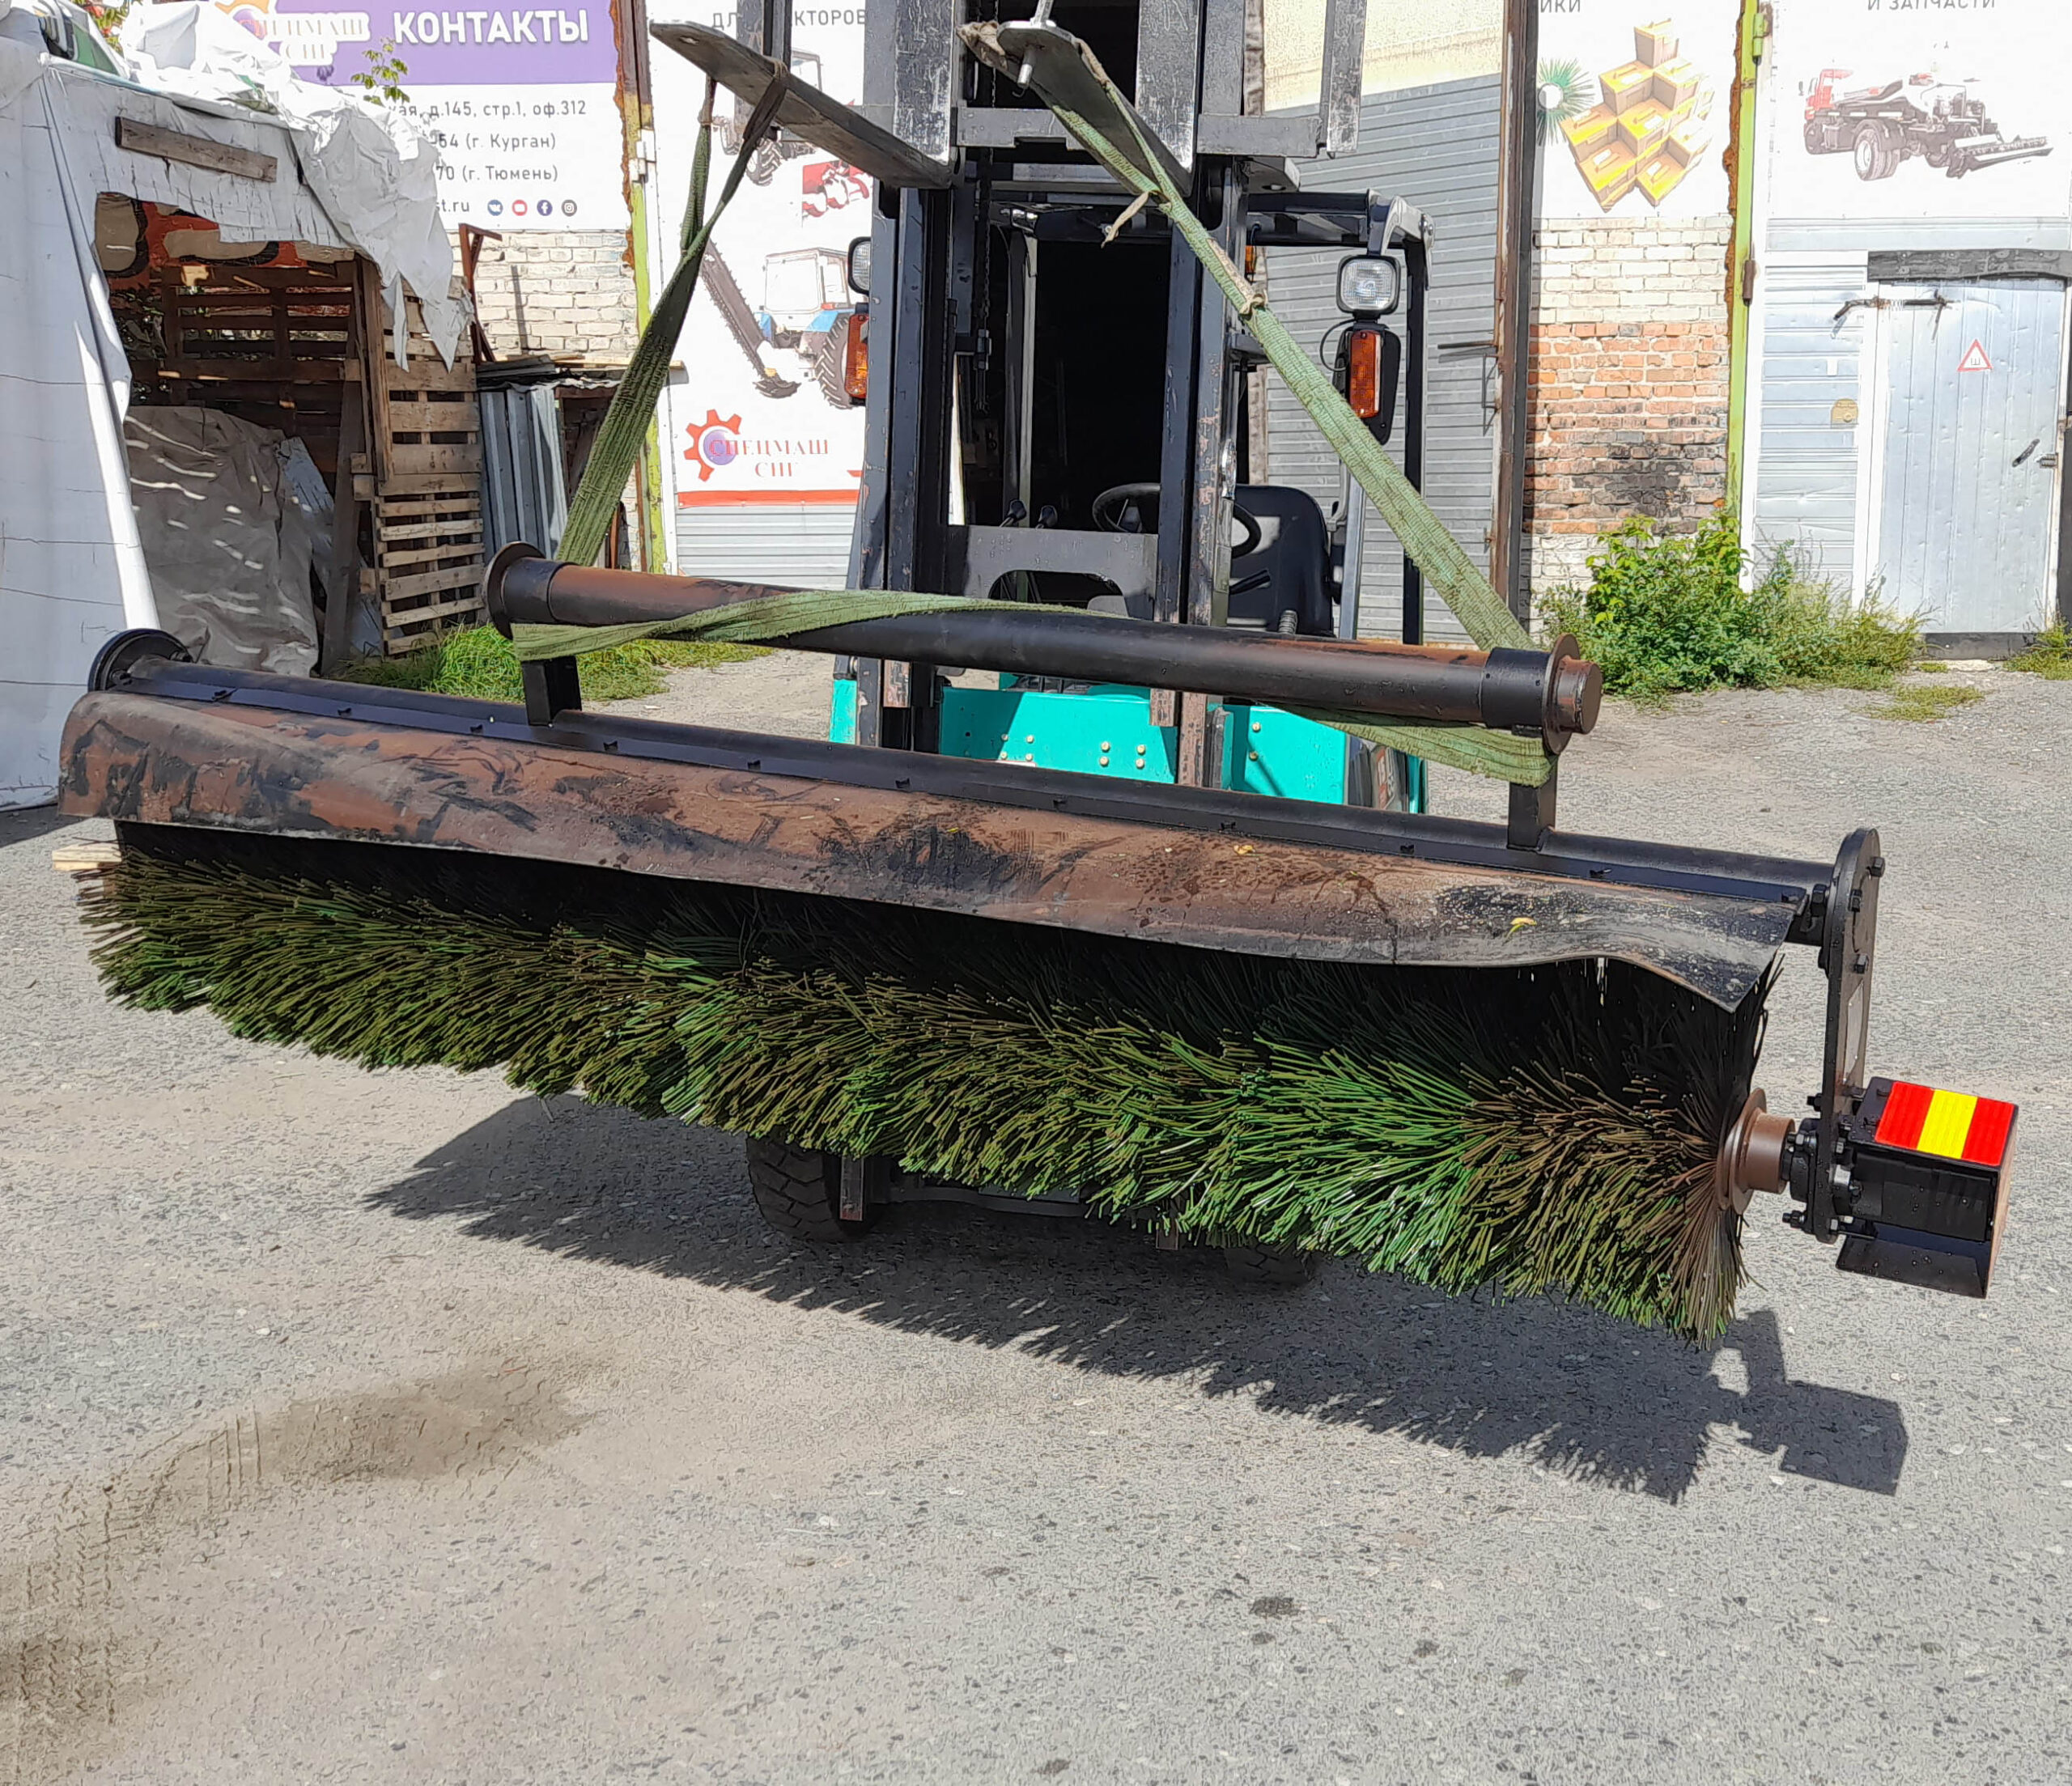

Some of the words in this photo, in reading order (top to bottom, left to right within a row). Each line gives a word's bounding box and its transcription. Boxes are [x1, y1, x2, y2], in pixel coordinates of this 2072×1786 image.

[393, 9, 588, 44] КОНТАКТЫ
[429, 101, 477, 118] д.145,
[483, 101, 526, 119] стр.1,
[533, 100, 586, 118] оф.312
[466, 133, 484, 150] (г.
[490, 133, 556, 151] Курган)
[463, 165, 481, 182] (г.
[486, 165, 558, 182] Тюмень)
